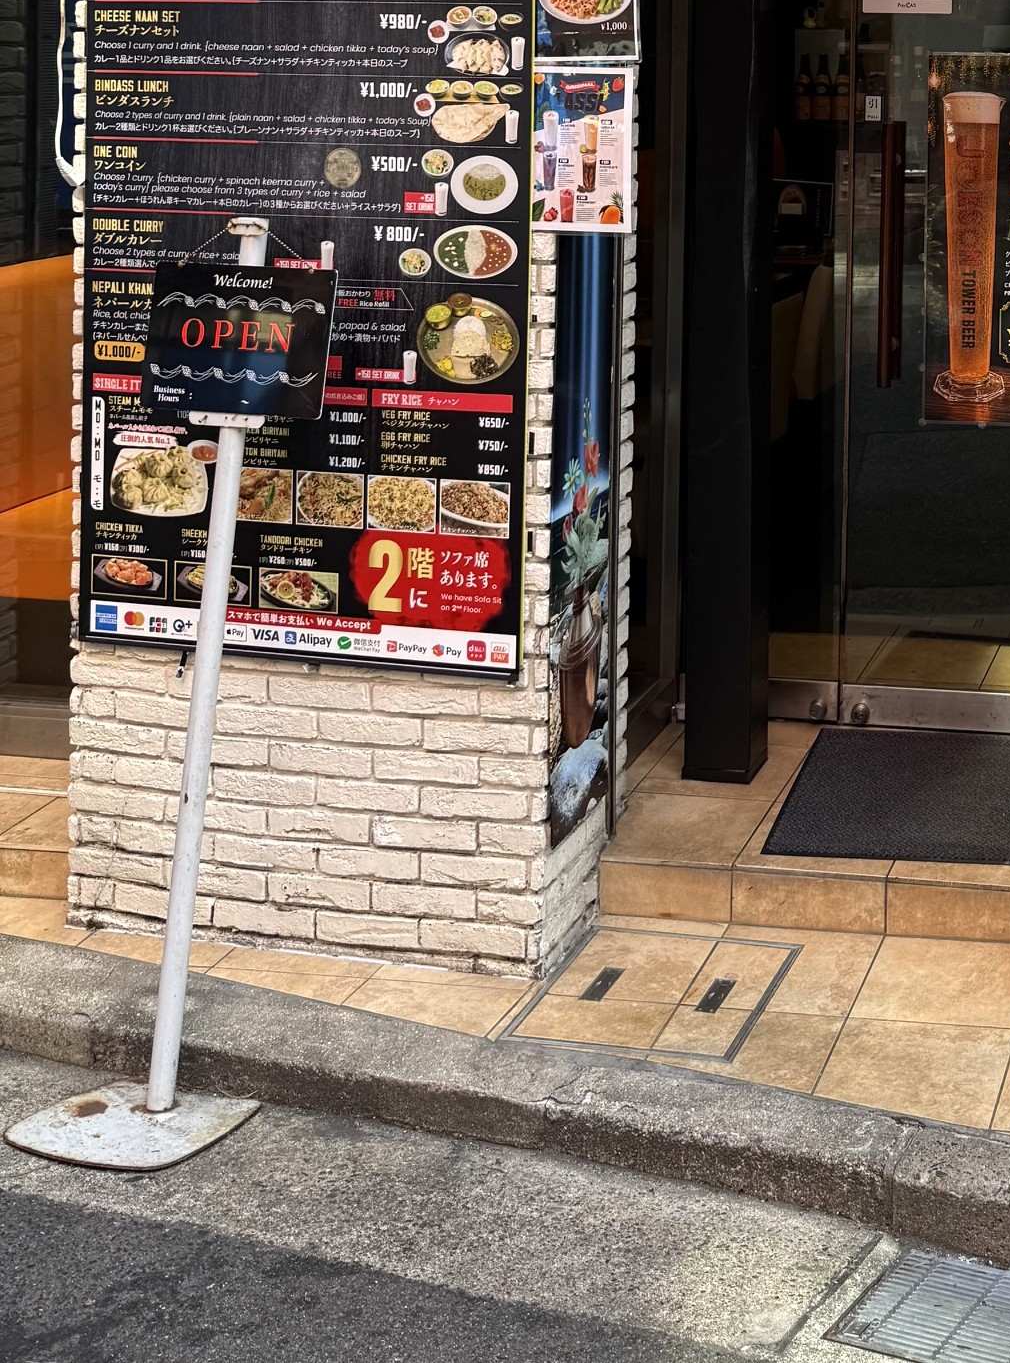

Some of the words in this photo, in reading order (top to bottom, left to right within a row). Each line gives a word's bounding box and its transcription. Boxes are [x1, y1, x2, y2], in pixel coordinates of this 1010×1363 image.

[94, 11, 131, 22] CHEESE
[135, 11, 158, 22] NAAN
[162, 11, 180, 22] SET
[380, 14, 427, 29] ¥980/-
[94, 24, 179, 37] チーズナンセット
[601, 21, 627, 31] ¥1,000
[95, 80, 133, 92] BINDASS
[137, 81, 168, 92] LUNCH
[95, 95, 174, 107] ビンダスランチ
[94, 147, 112, 158] ONE
[115, 147, 137, 158] COIN
[94, 159, 145, 171] ワンコイン
[93, 219, 130, 232] DOUBLE
[133, 220, 163, 232] CURRY
[93, 233, 162, 245] ダブルカレー
[214, 272, 273, 289] Welcome!
[962, 271, 976, 314] TOWER
[180, 318, 295, 353] OPEN
[962, 321, 975, 348] BEER
[154, 385, 185, 395] Business
[158, 394, 179, 402] Hours
[381, 395, 399, 405] FRY
[402, 395, 422, 406] RICE
[427, 397, 459, 406] チャハン
[441, 551, 489, 567] ソファ席
[369, 539, 403, 612] 2
[407, 548, 435, 577] 階
[441, 572, 498, 589] あります。
[251, 628, 279, 642] VISA
[299, 633, 332, 647] Alipay
[399, 643, 427, 654] PayPay
